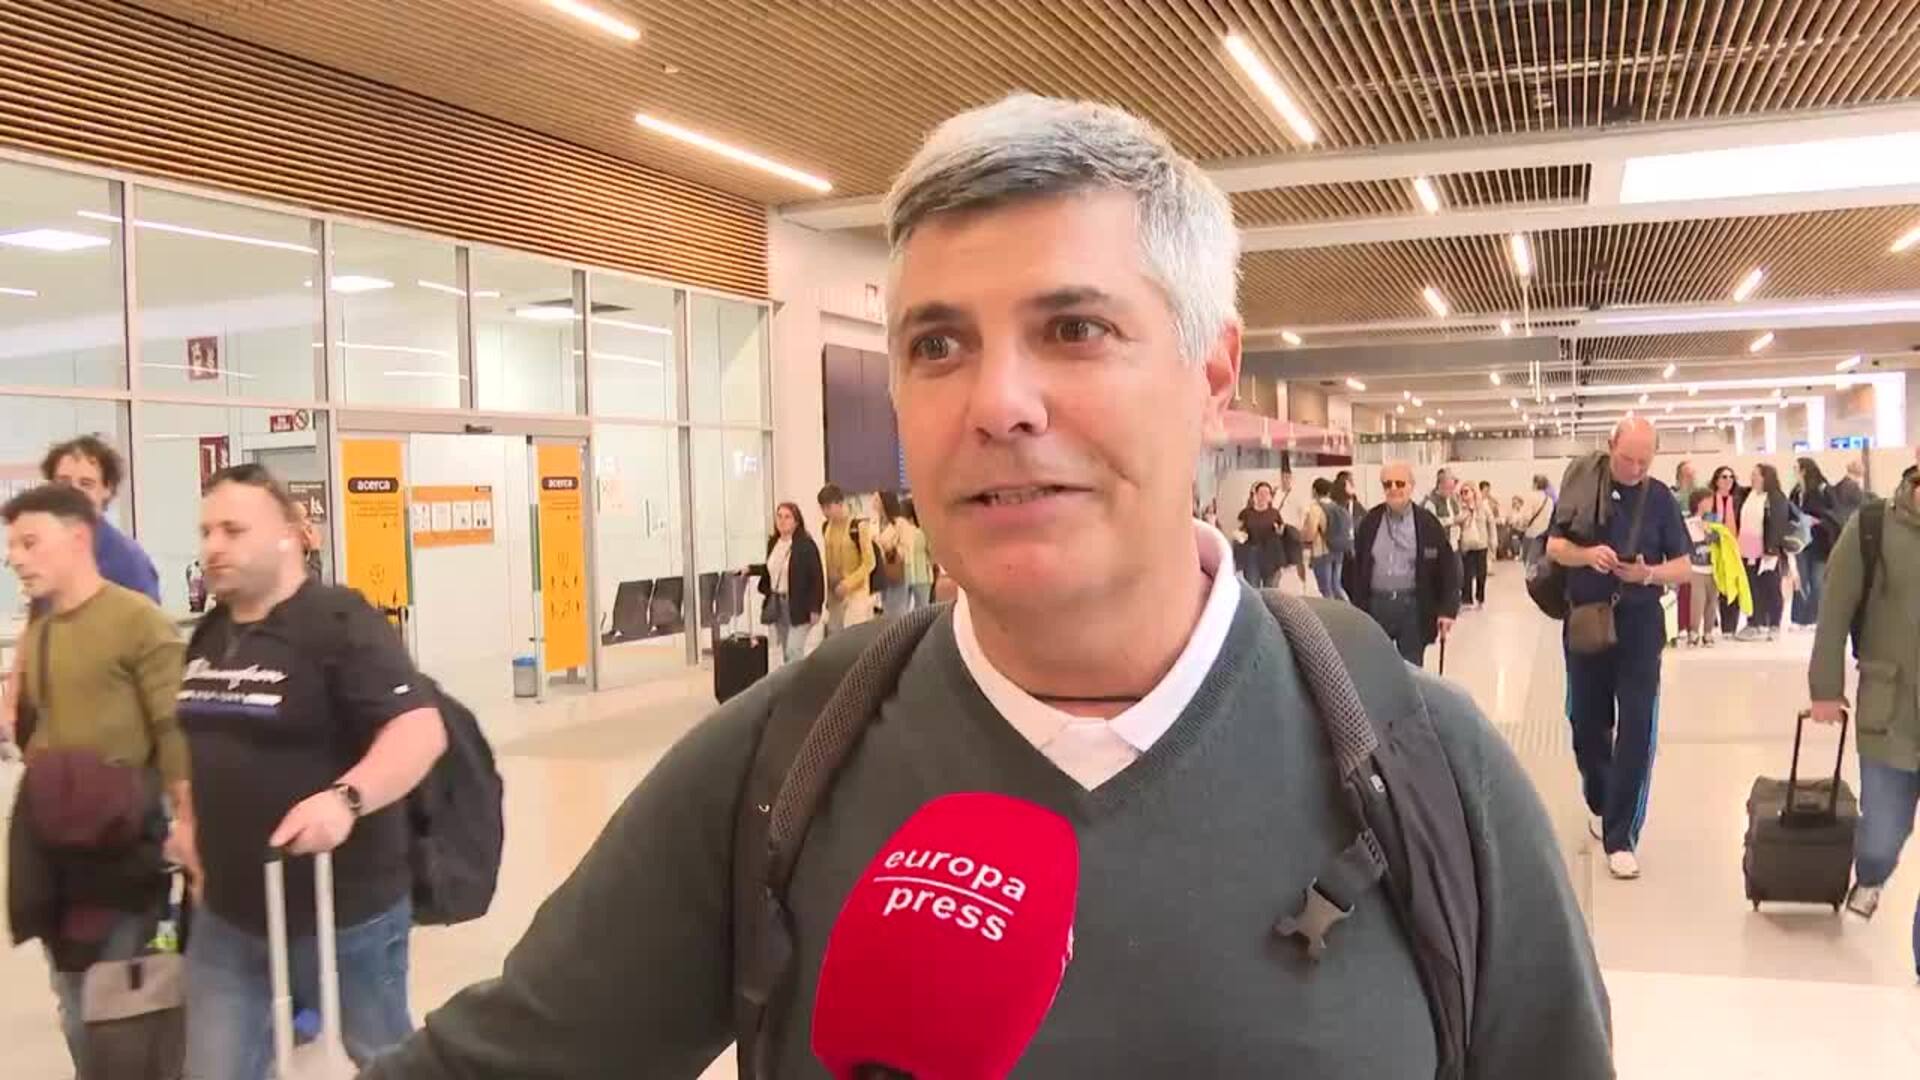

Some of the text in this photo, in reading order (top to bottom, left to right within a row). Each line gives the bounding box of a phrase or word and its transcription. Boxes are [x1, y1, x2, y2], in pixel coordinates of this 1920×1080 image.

[356, 480, 391, 490] acerca
[884, 850, 1026, 902] europa
[882, 887, 1007, 941] press
